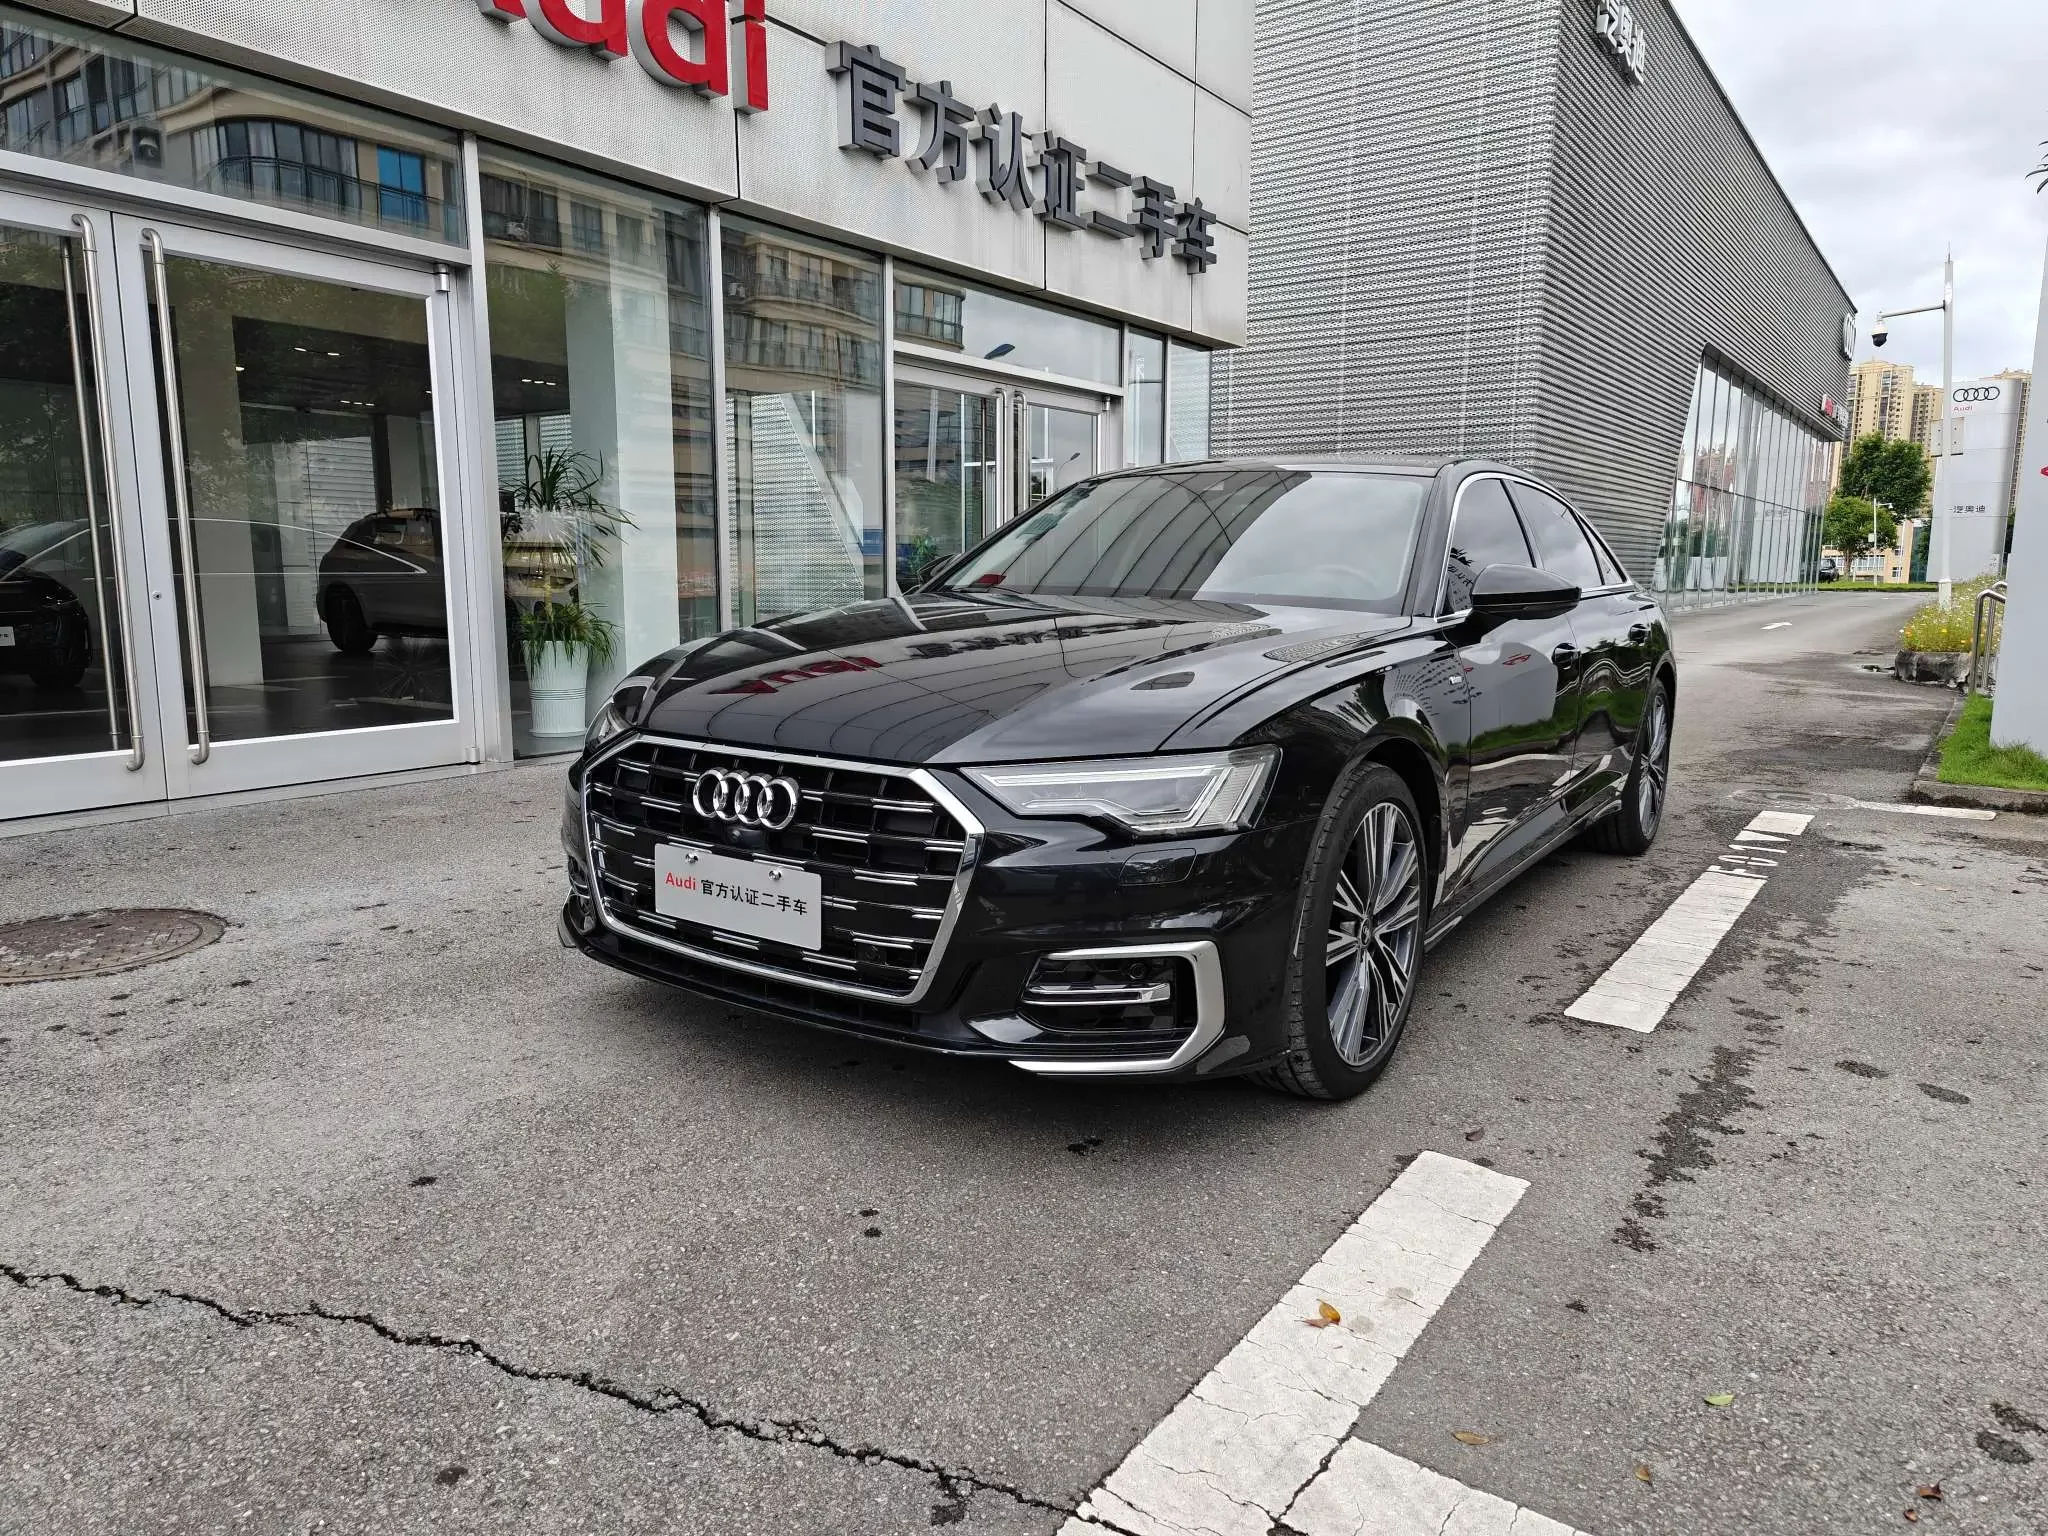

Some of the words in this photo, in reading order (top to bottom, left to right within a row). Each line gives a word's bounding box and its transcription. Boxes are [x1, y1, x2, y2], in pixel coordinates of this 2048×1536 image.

[478, 0, 768, 114] udi
[825, 39, 1217, 275] 官方认证二手车
[1953, 404, 1973, 412] Audi
[665, 871, 697, 891] Audi
[700, 879, 808, 916] 官方认证二手车
